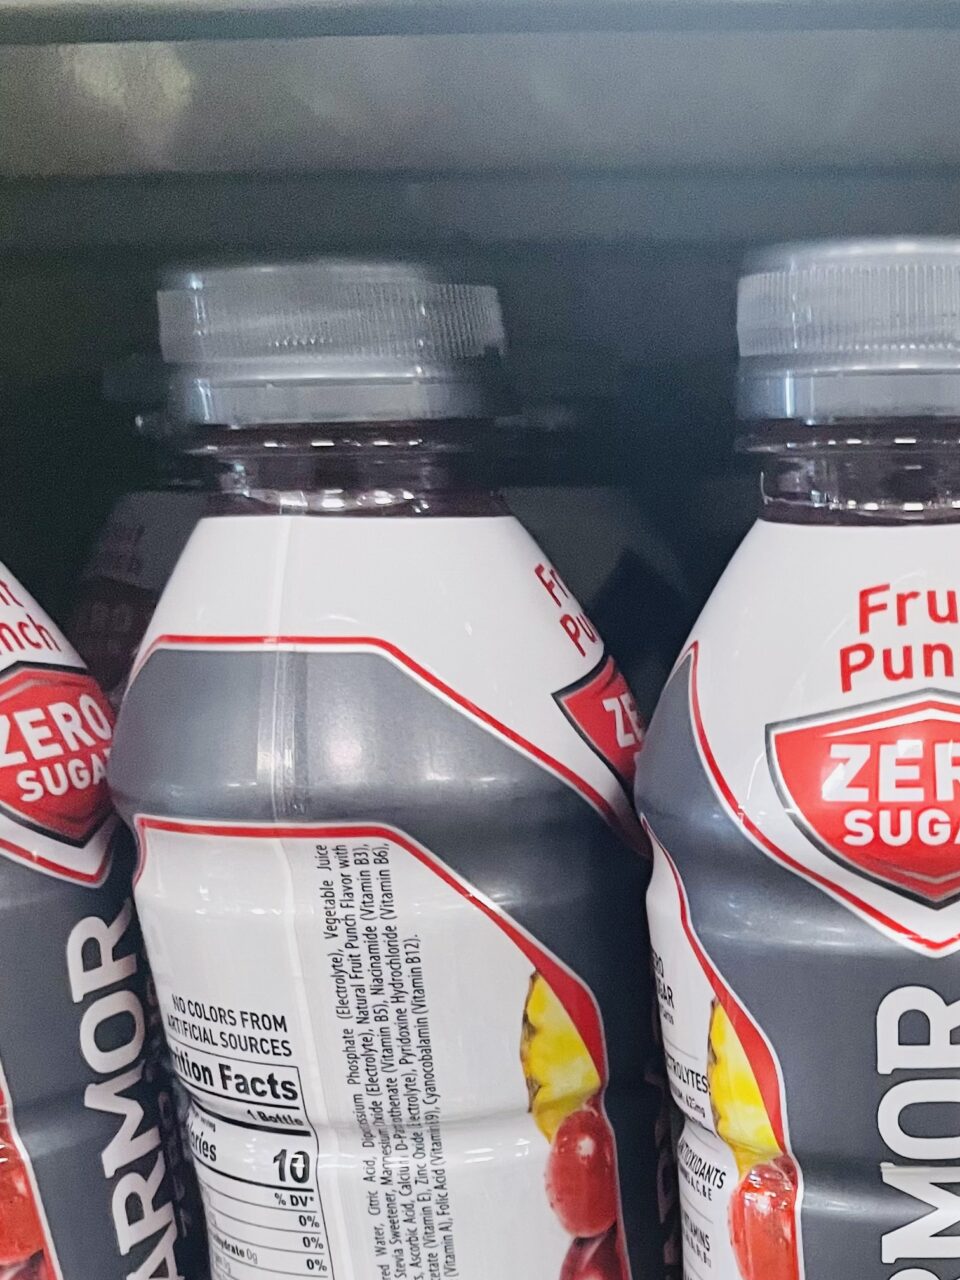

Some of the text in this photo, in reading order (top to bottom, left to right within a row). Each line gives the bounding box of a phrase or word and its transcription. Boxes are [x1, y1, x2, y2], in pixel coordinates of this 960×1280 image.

[16, 748, 110, 803] SUGA
[314, 845, 332, 871] Juice
[334, 845, 351, 870] with
[352, 843, 369, 866] B3),
[372, 843, 390, 865] B6),
[319, 880, 339, 939] Vegetable
[339, 873, 356, 909] Flavor
[356, 870, 378, 920] (Vitamin
[376, 869, 397, 920] (Vitamin
[342, 914, 360, 949] Punch
[347, 953, 364, 979] Fruit
[363, 925, 385, 995] Niacinamide
[381, 925, 409, 1003] Hydrochloride
[328, 948, 353, 1019] (Electrolyte),
[188, 999, 237, 1027] COLORS
[240, 1010, 288, 1033] FROM
[353, 983, 371, 1024] Natural
[403, 934, 441, 1104] Cyanocobalamin (Vitamin B12).
[219, 1031, 292, 1057] SOURCES
[374, 1026, 397, 1073] (Vitamin
[394, 1007, 418, 1064] Pyridoxine
[341, 1028, 359, 1084] Phosphate
[358, 1028, 382, 1096] (Electrolyte),
[218, 1062, 299, 1101] Facts
[273, 1148, 311, 1184] 10
[299, 1215, 321, 1229] 0%
[303, 1236, 324, 1250] 0%
[306, 1258, 328, 1272] 0%
